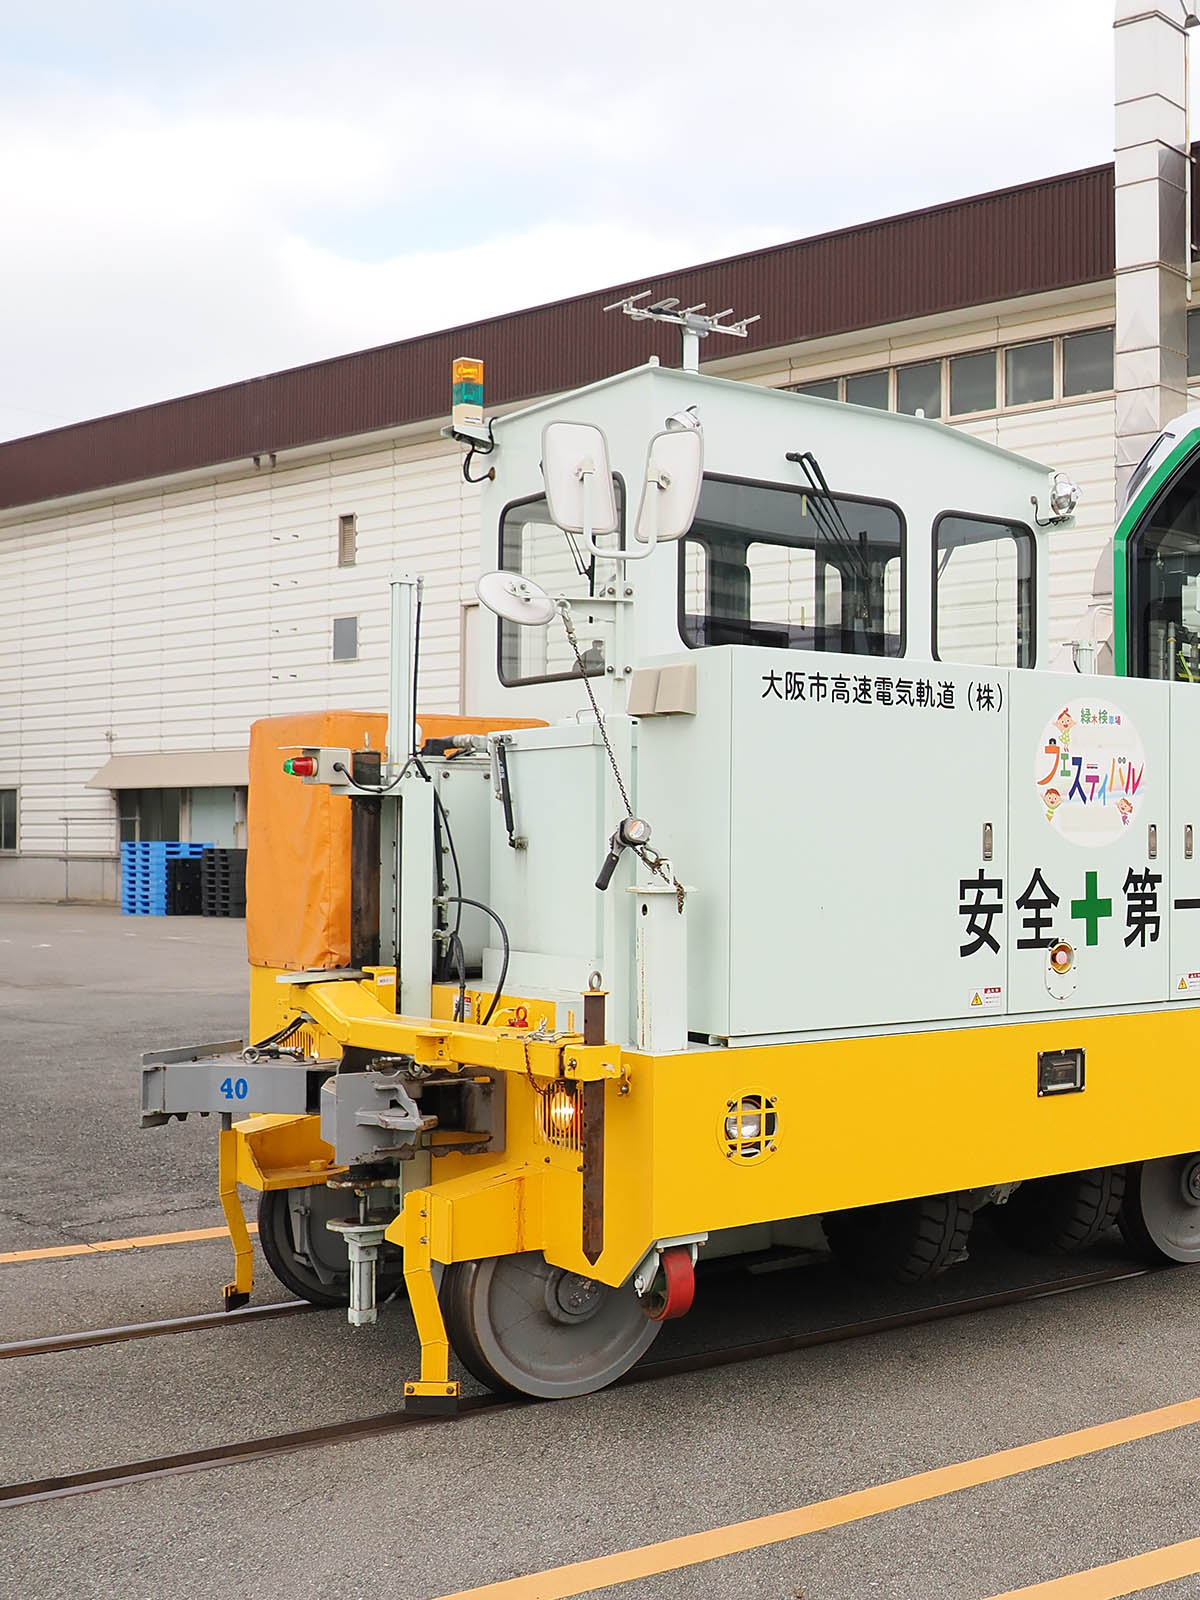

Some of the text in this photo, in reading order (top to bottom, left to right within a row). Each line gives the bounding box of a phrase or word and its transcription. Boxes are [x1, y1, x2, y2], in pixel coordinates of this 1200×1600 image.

[1037, 738, 1144, 806] フェスティバル
[220, 1077, 249, 1100] 40
